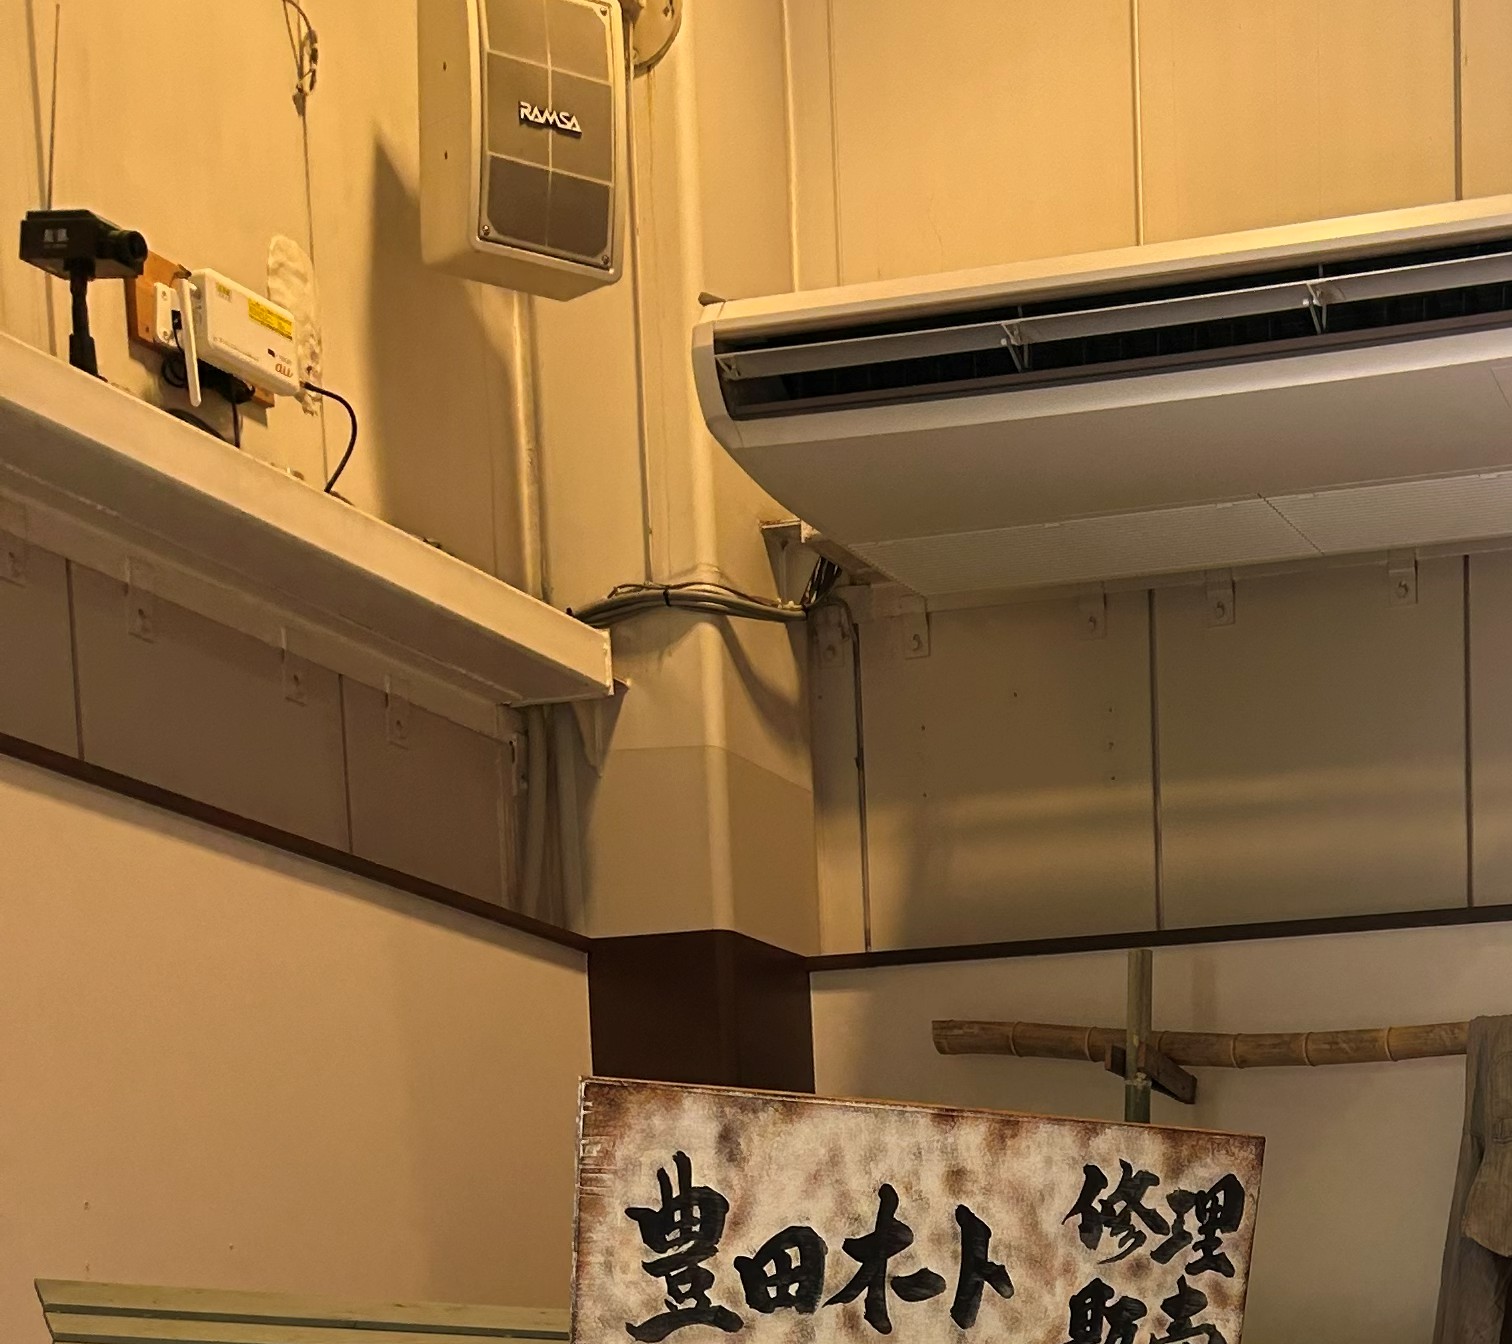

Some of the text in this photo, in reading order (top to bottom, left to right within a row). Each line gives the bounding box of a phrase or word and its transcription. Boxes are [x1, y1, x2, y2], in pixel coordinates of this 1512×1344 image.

[519, 100, 583, 133] RAMSA
[275, 363, 293, 378] au
[625, 1150, 1014, 1344] 豊田オート
[1062, 1158, 1246, 1278] 修理
